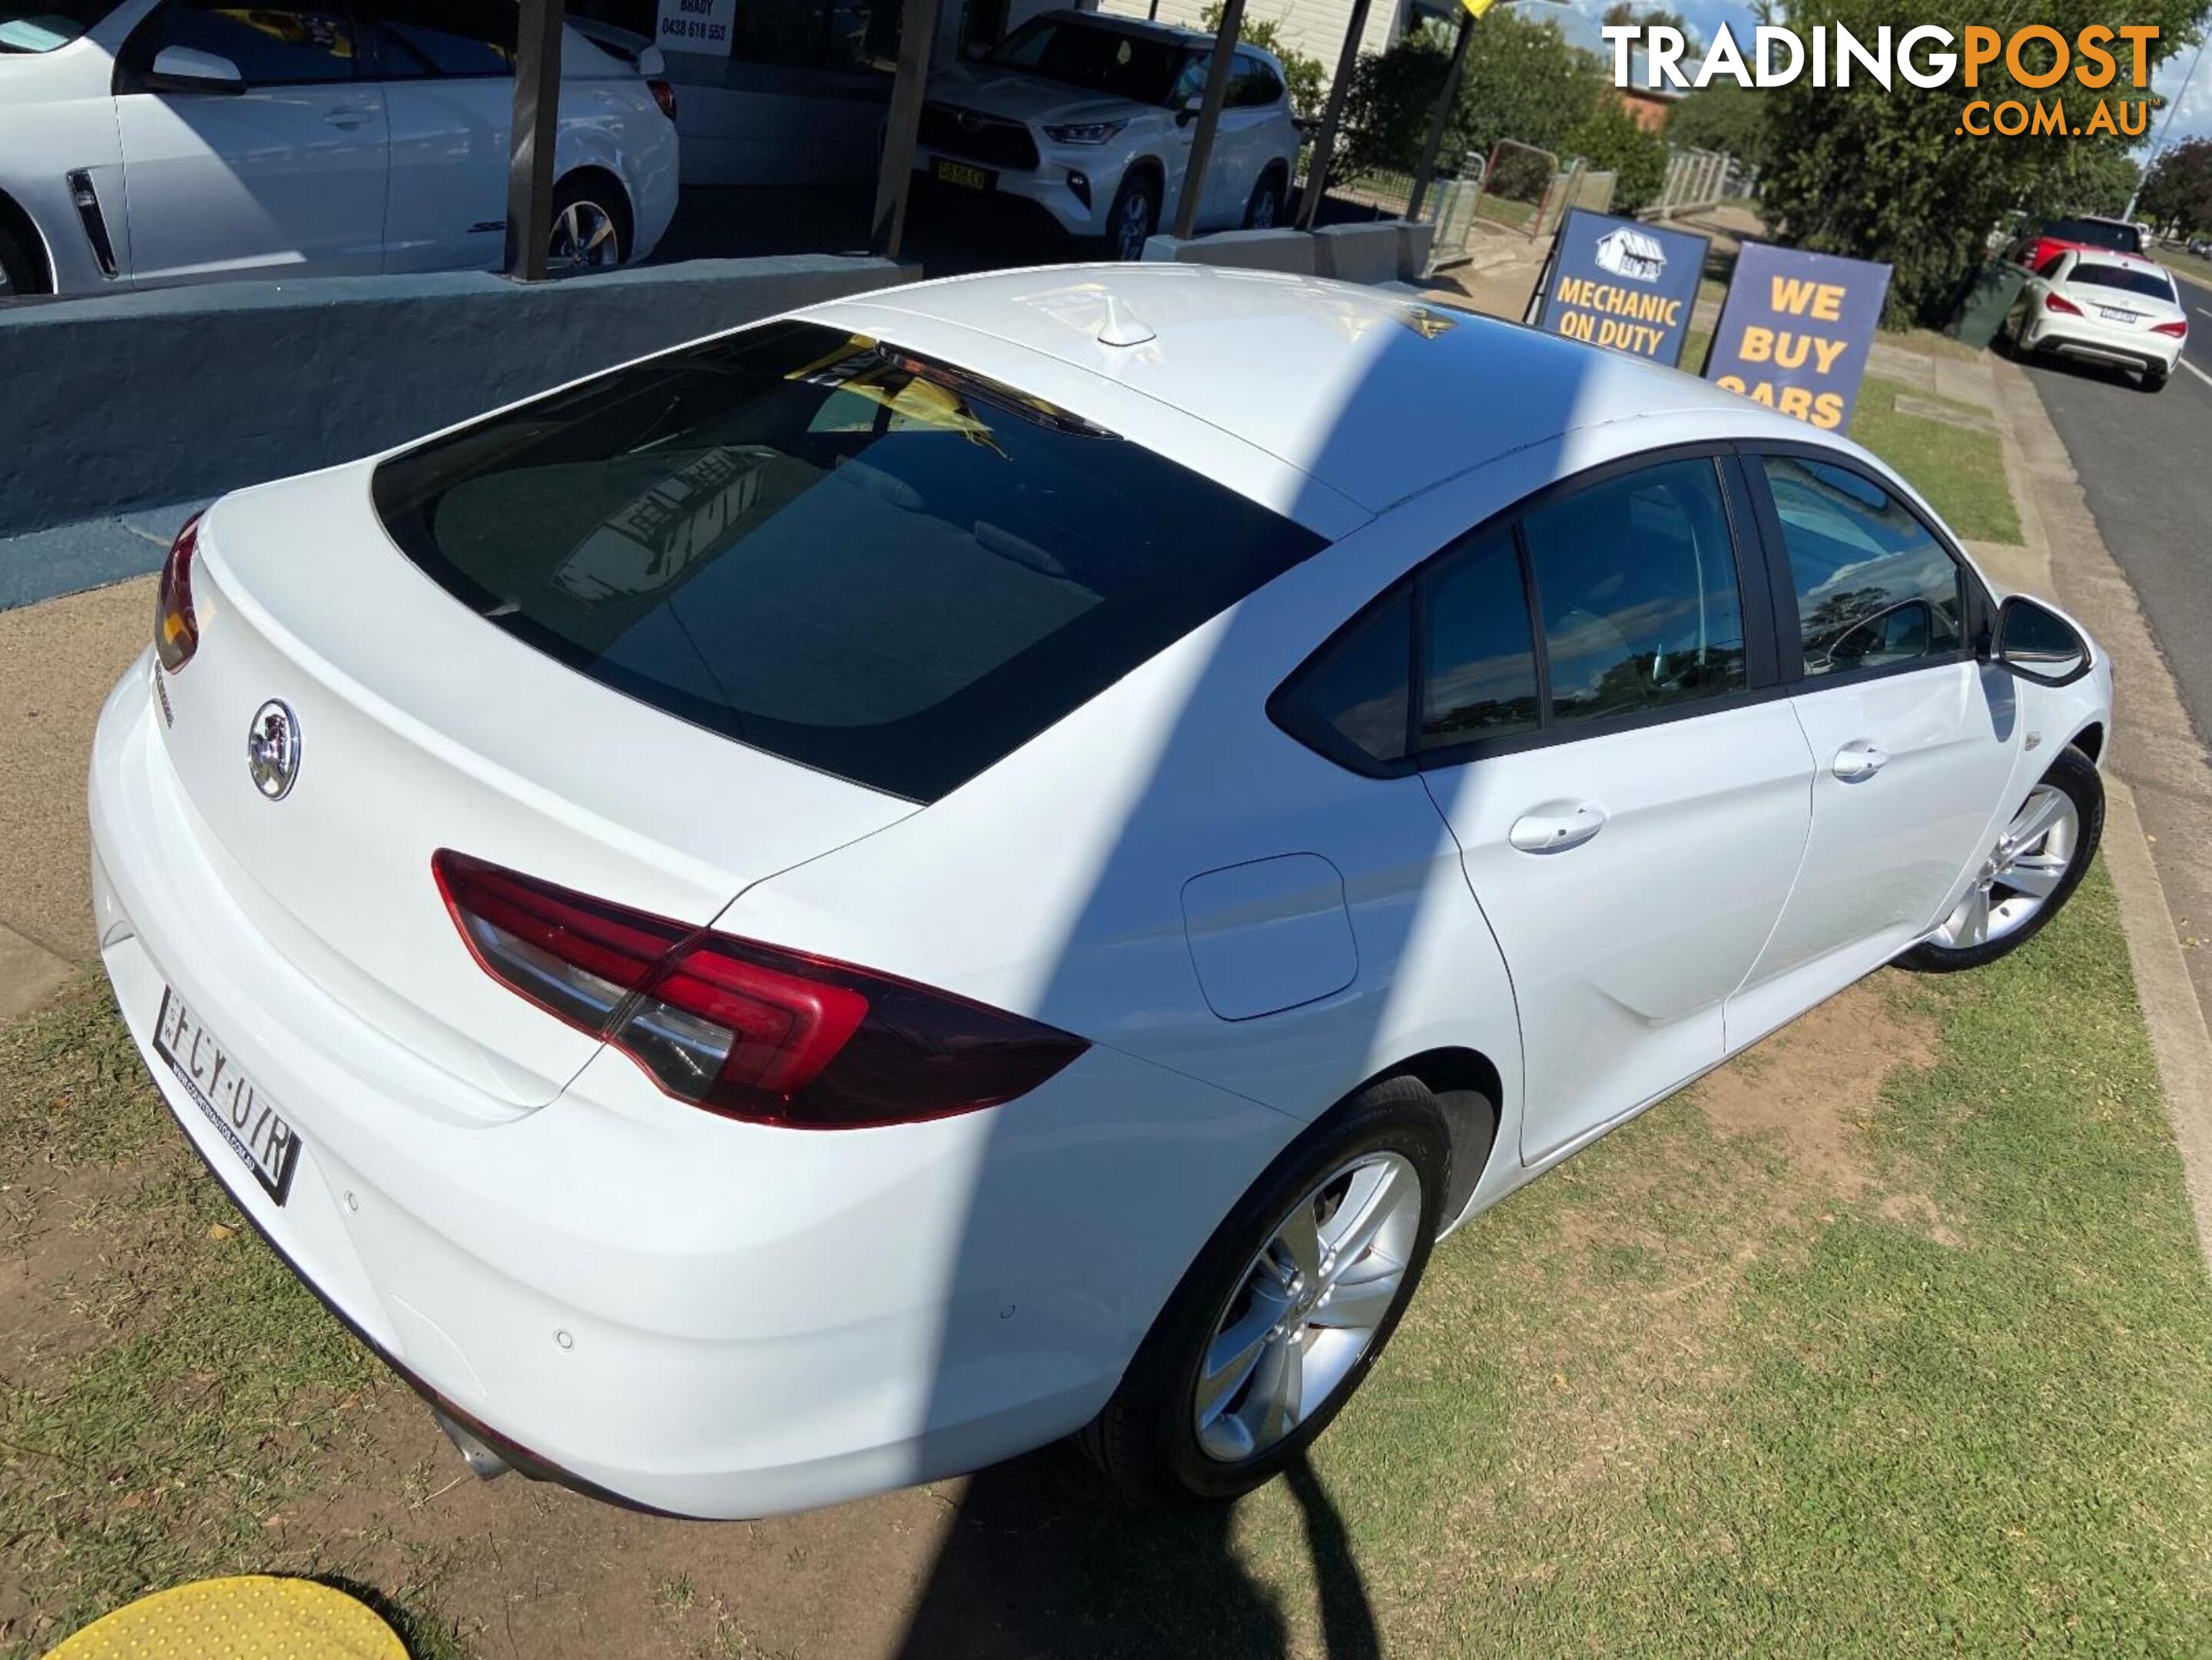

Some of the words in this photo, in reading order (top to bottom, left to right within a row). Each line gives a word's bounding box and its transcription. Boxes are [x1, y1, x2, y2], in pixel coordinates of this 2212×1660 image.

[663, 18, 687, 35] 0438
[680, 0, 714, 15] BRADY
[1557, 276, 1682, 327] MECHANIC
[1771, 275, 1846, 322] WE
[1560, 310, 1596, 342] ON
[1597, 318, 1665, 355] DUTY
[1738, 324, 1848, 375] BUY
